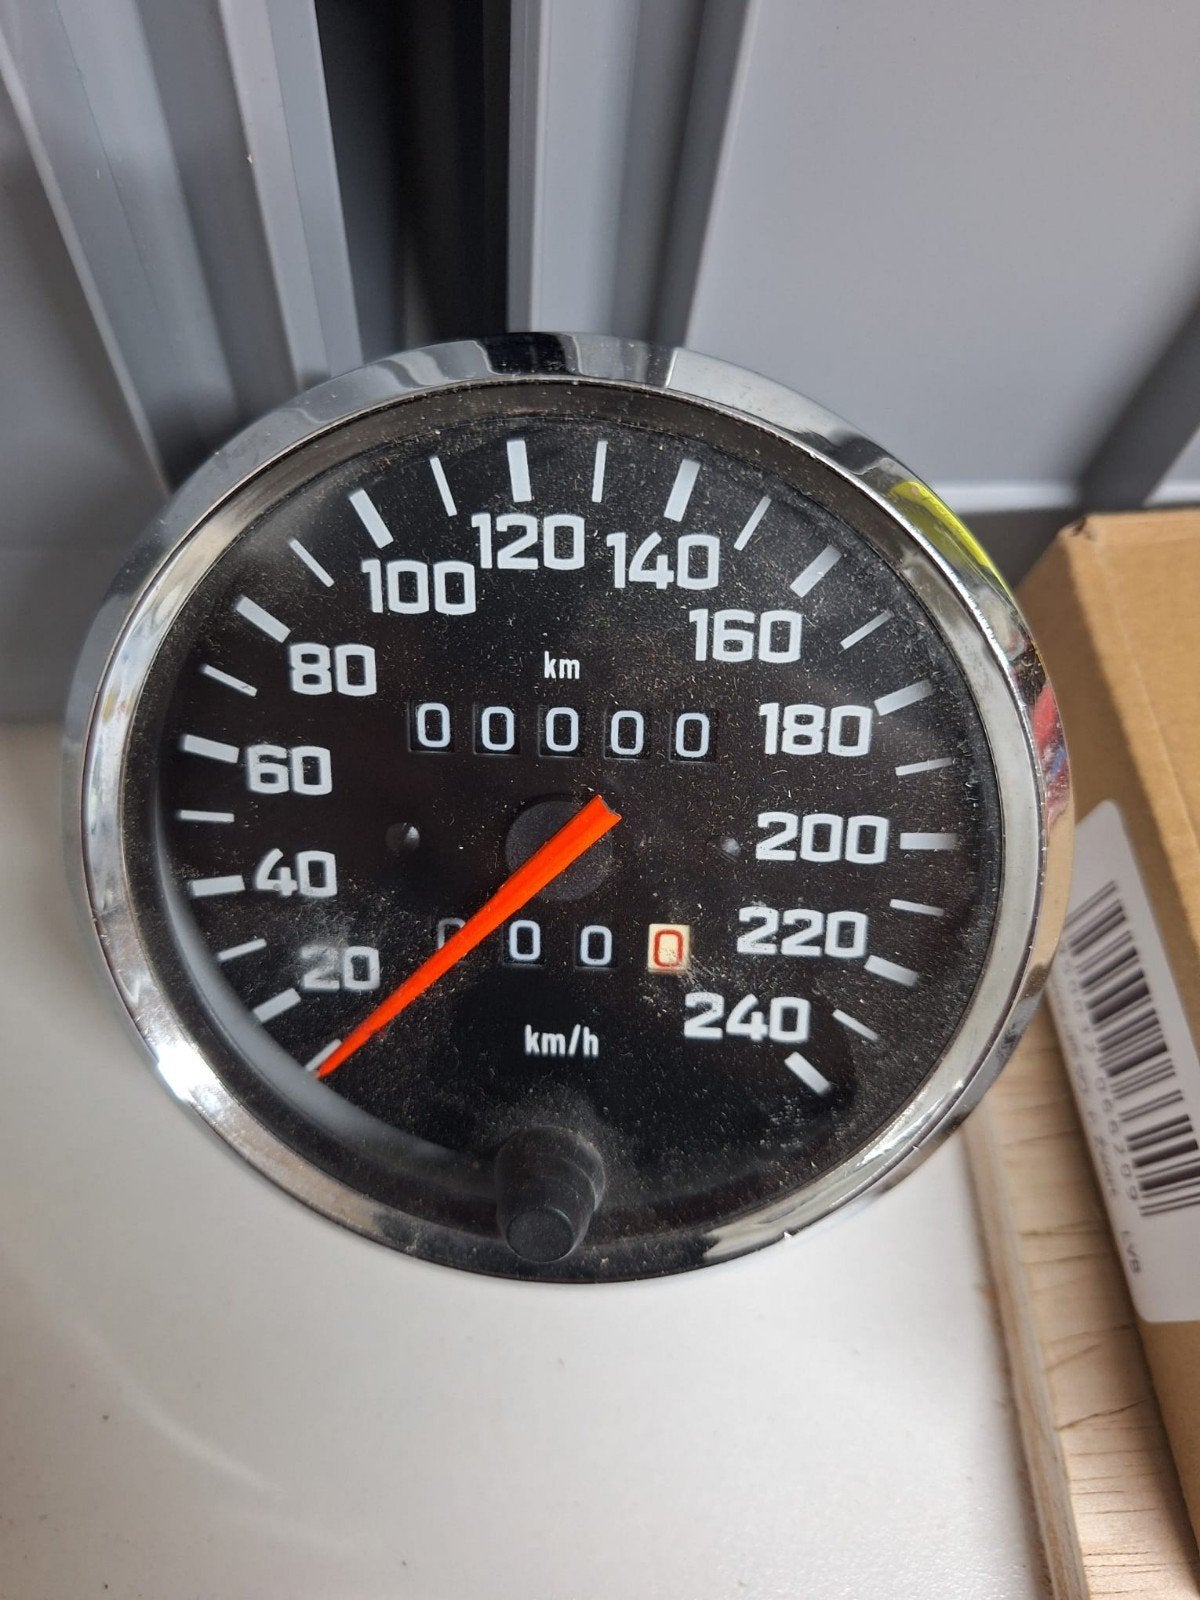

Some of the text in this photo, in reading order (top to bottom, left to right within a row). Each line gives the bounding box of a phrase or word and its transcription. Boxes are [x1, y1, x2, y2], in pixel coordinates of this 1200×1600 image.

[471, 512, 586, 571] 120
[605, 531, 722, 591] 140
[360, 558, 477, 616] 100
[688, 608, 804, 664] 160
[289, 642, 378, 697] 80
[543, 650, 581, 681] km
[758, 702, 874, 757] 180
[246, 743, 333, 796] 60
[755, 811, 890, 865] 200
[254, 848, 338, 899] 40
[736, 907, 869, 959] 220
[299, 943, 381, 993] 20
[523, 1023, 600, 1058] km/h
[683, 990, 811, 1044] 240
